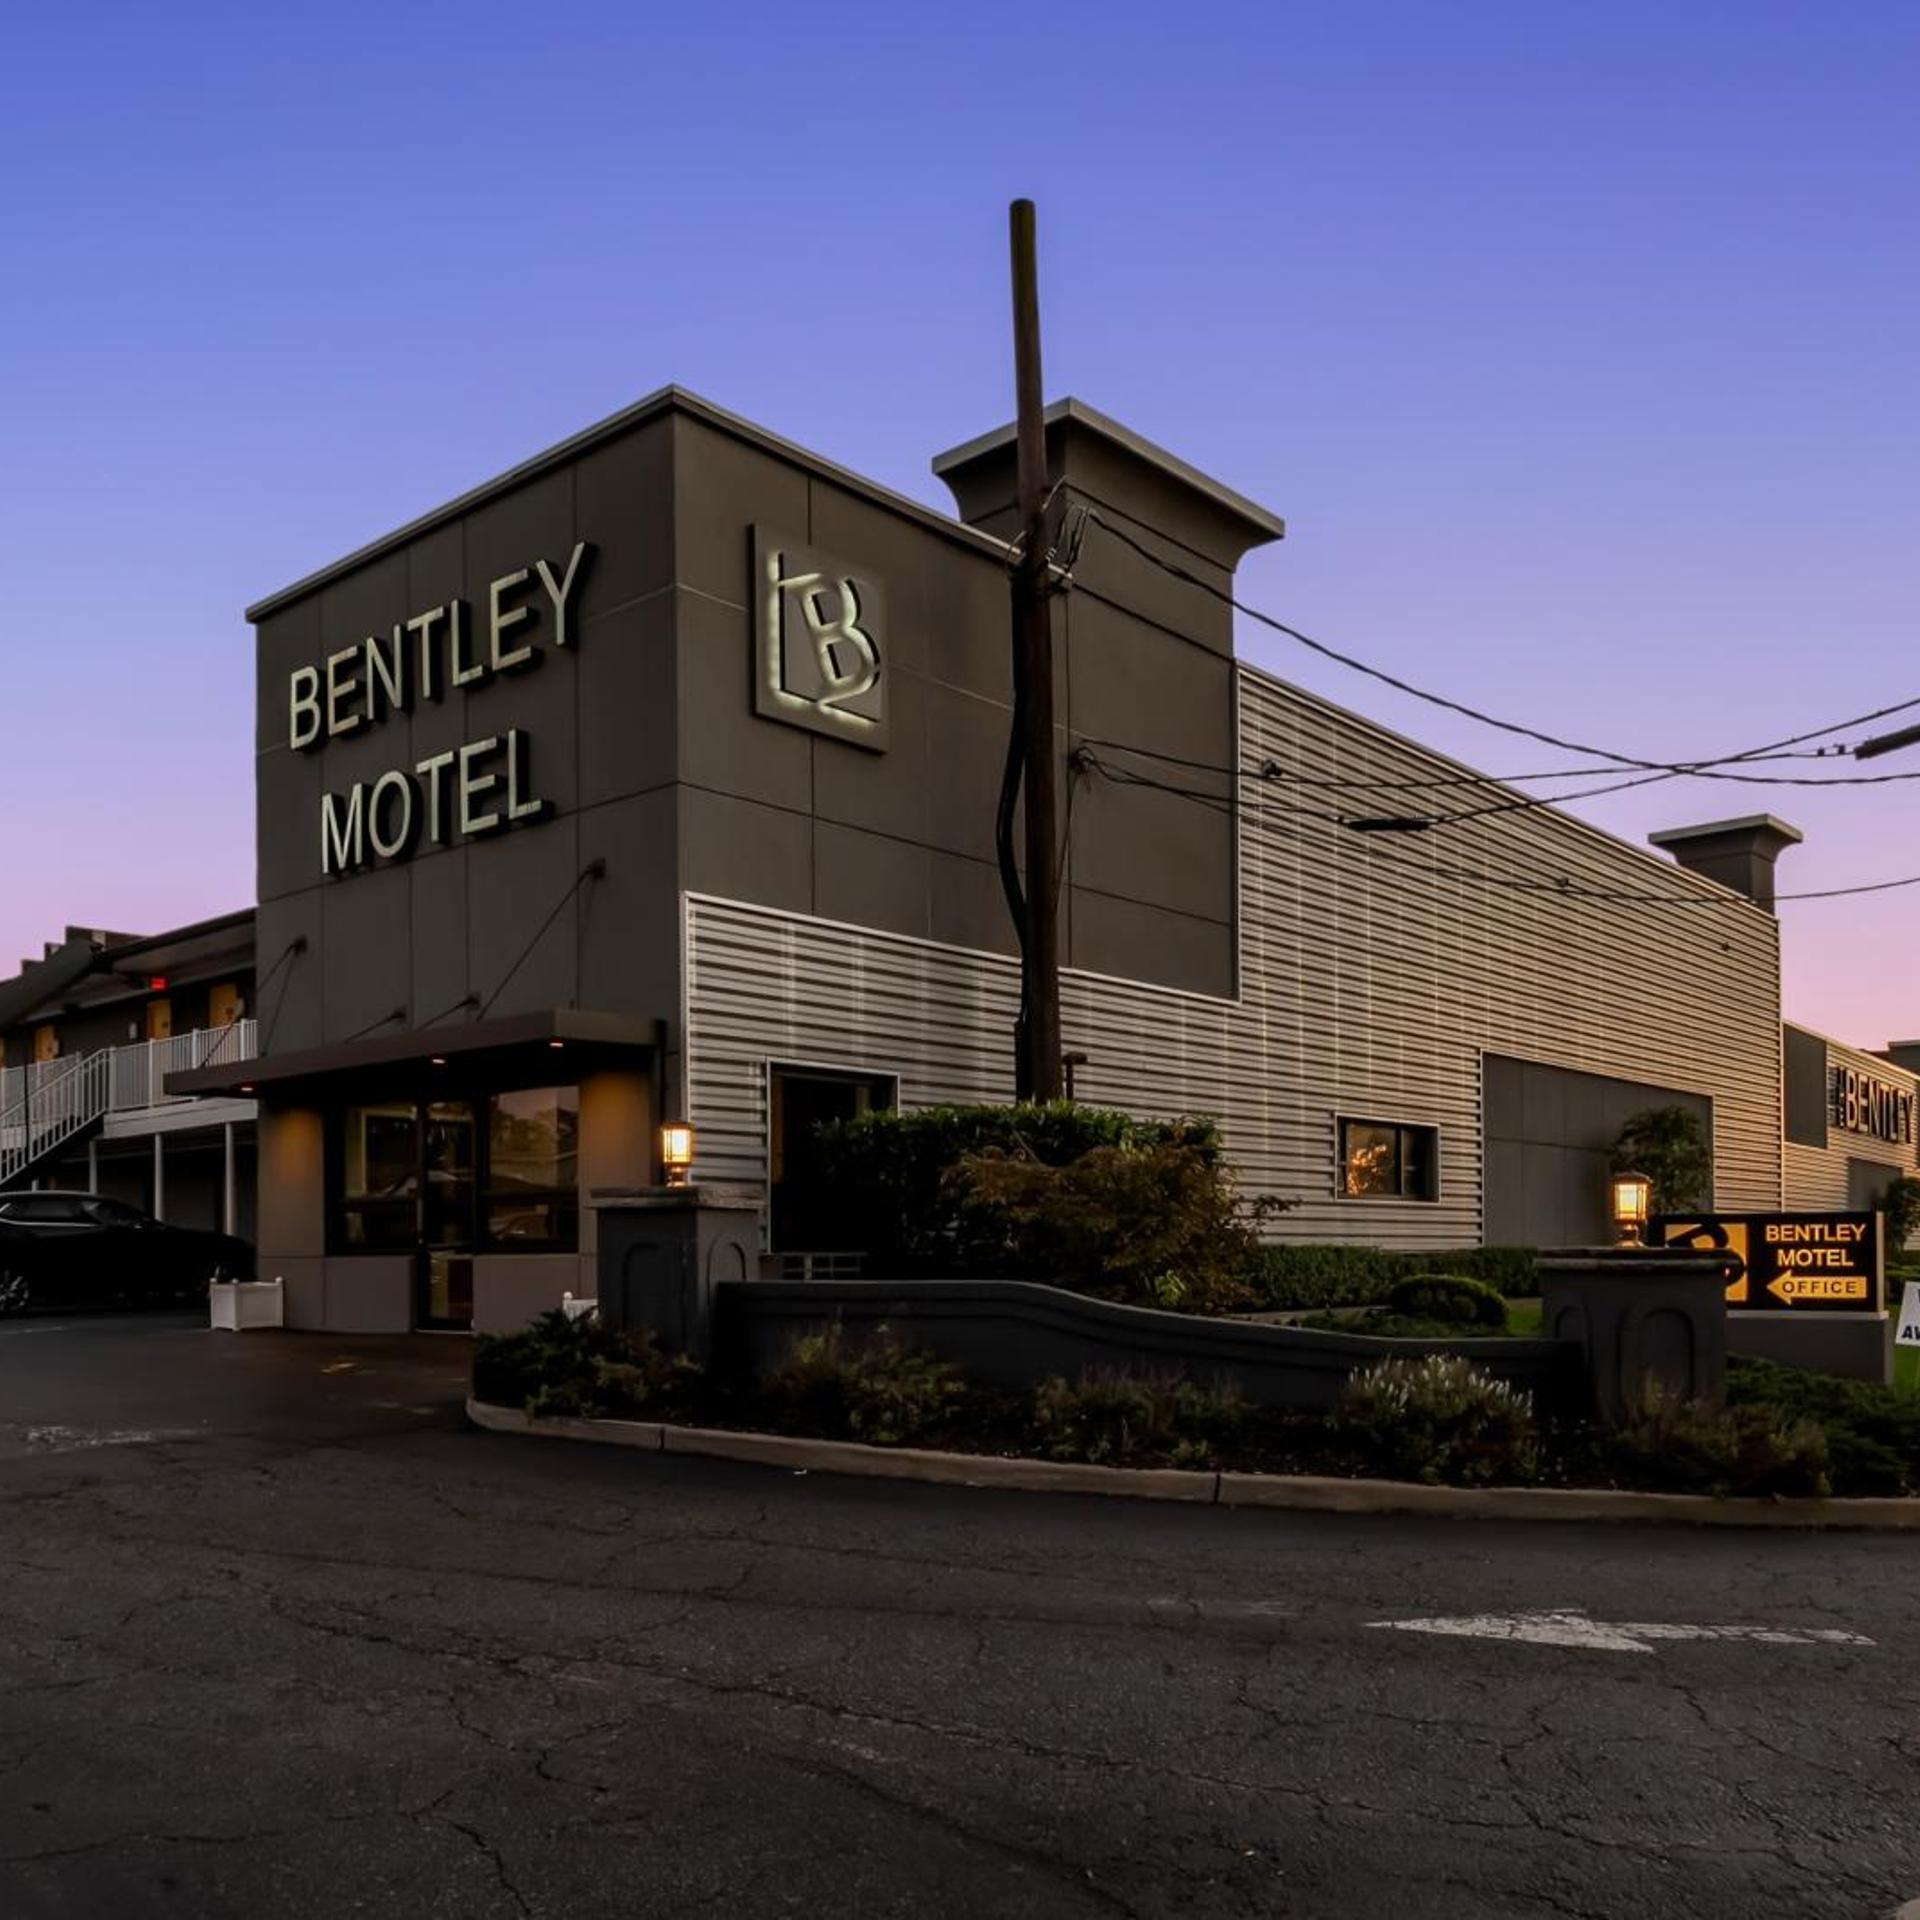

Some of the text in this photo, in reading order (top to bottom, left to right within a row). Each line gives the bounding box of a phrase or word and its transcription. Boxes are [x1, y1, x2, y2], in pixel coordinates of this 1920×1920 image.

[290, 542, 593, 750] BENTLEY
[321, 728, 543, 875] MOTEL
[1845, 1068, 1914, 1146] BENTLEY
[1765, 1223, 1867, 1242] BENTLEY
[1777, 1248, 1854, 1267] MOTEL
[1782, 1280, 1858, 1294] OFFICE
